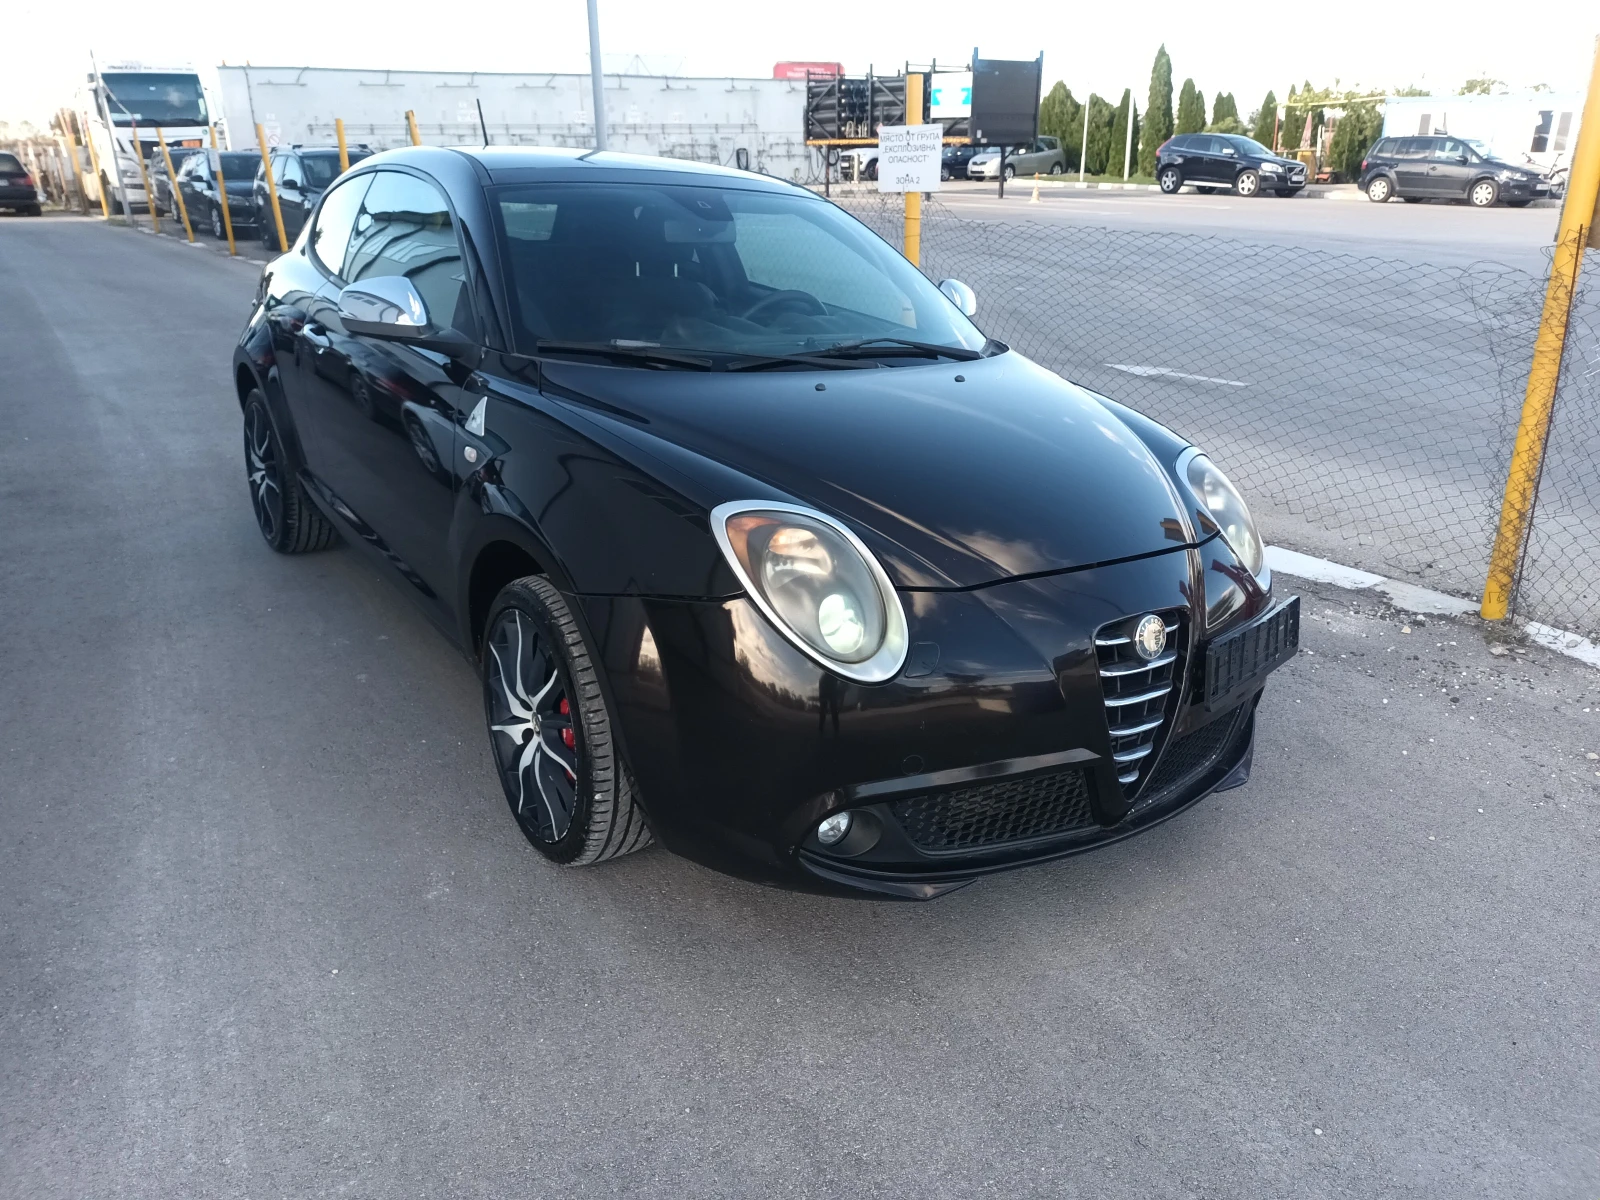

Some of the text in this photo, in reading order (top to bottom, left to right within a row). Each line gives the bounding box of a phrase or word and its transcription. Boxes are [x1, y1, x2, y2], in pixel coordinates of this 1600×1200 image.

[880, 132, 940, 142] МЯСТО ОТ ГРУПА
